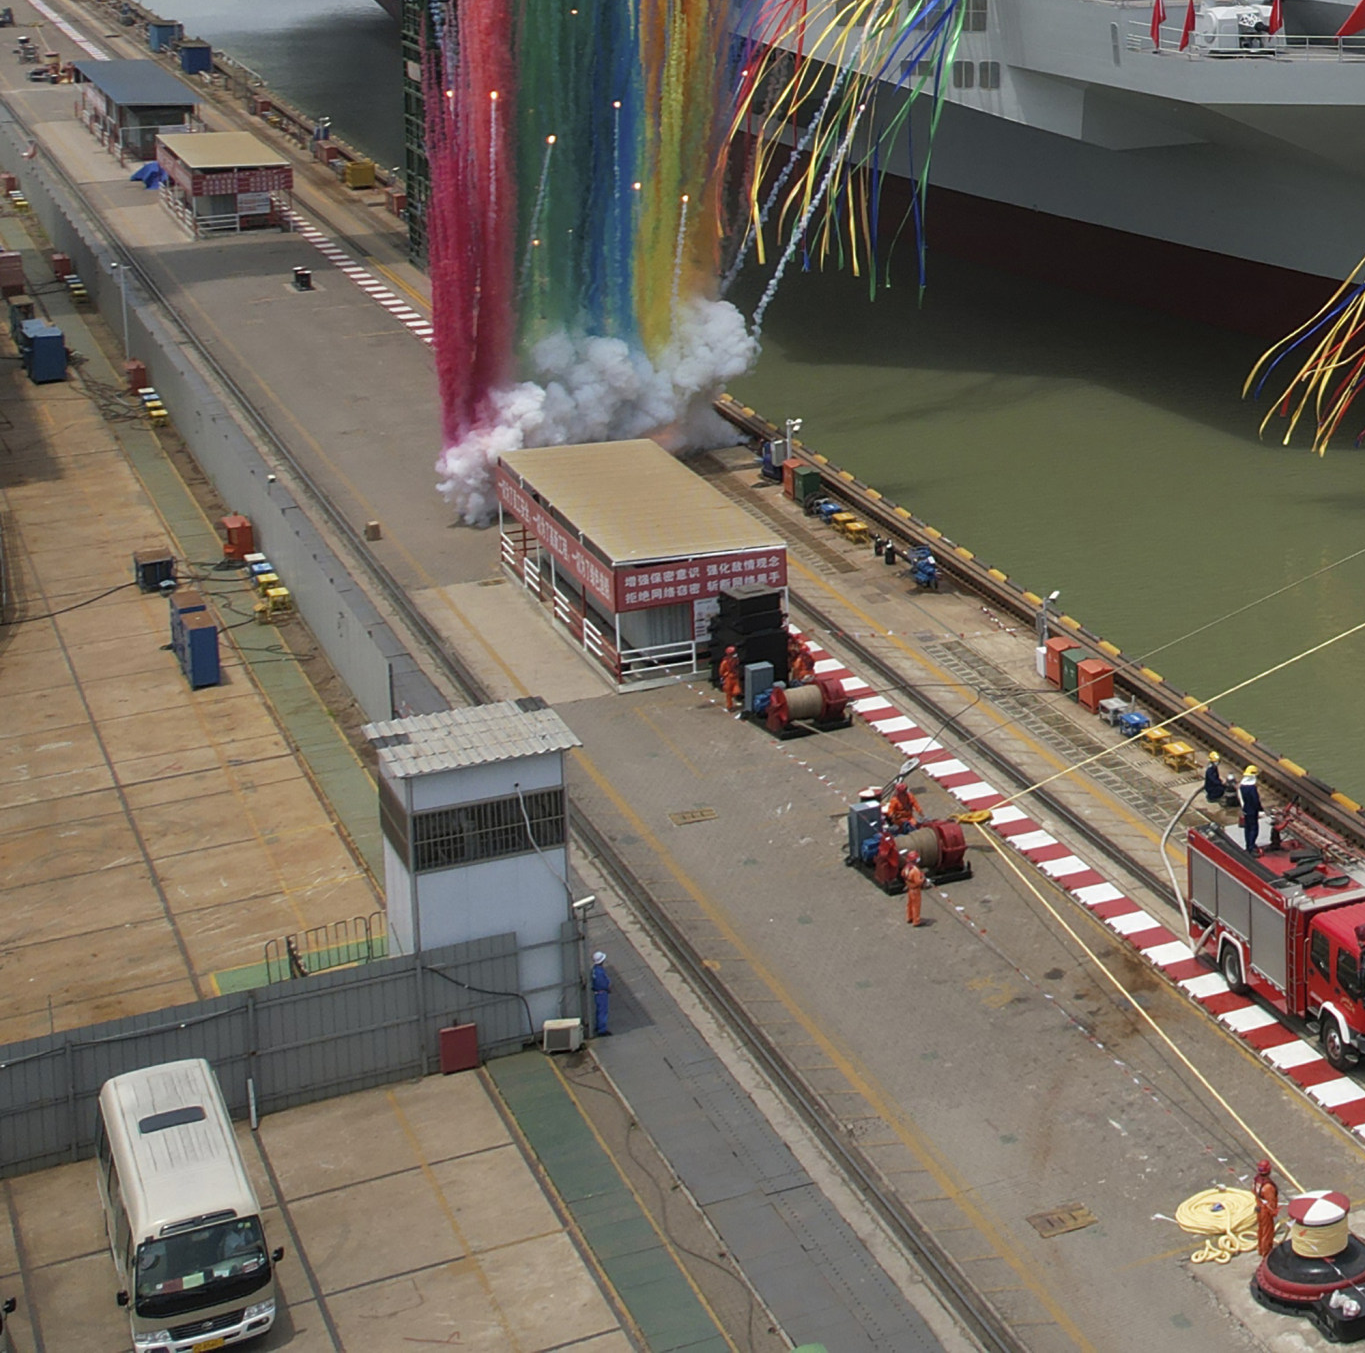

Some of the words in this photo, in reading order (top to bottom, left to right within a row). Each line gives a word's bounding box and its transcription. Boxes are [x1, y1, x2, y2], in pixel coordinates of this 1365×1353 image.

[625, 567, 700, 588] 增强保密意识
